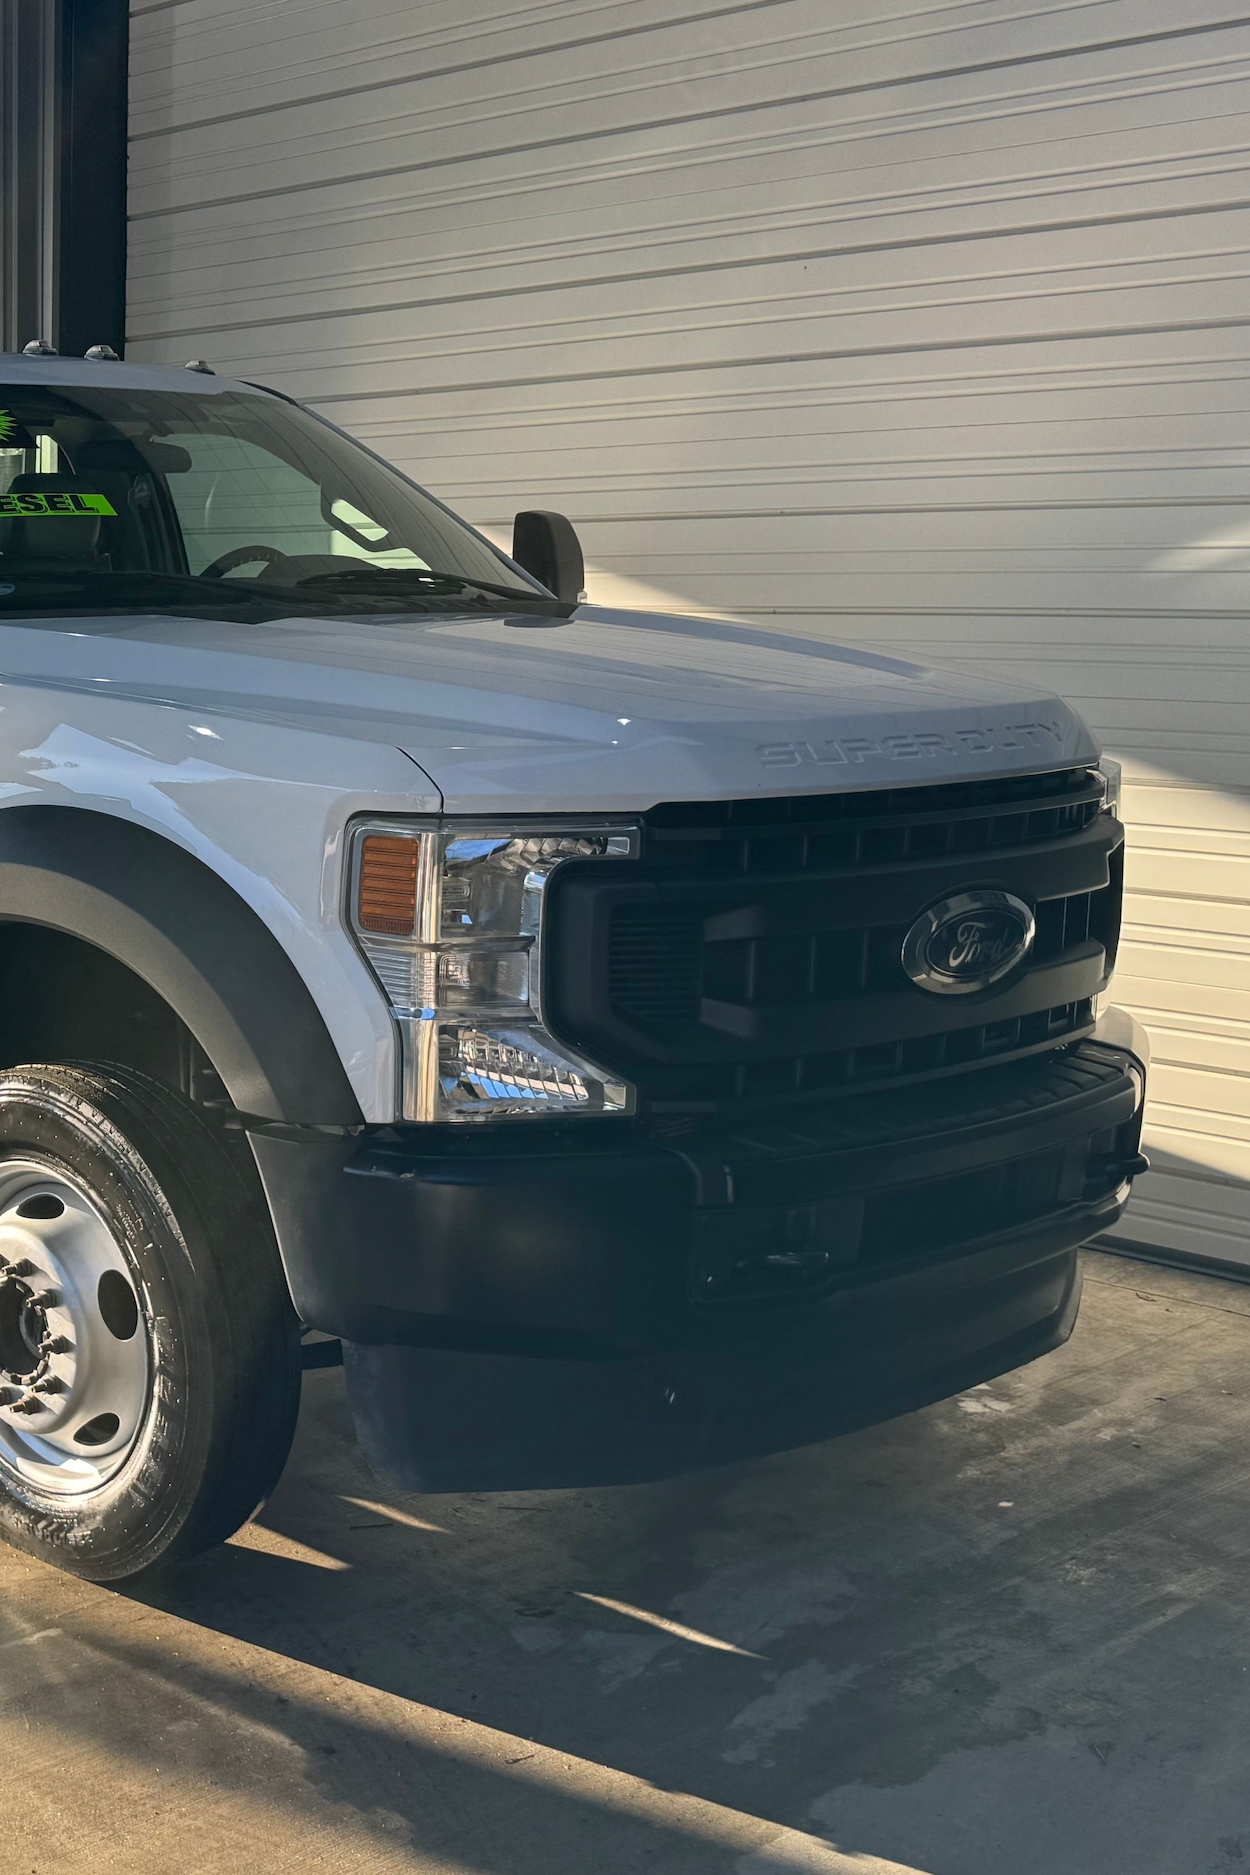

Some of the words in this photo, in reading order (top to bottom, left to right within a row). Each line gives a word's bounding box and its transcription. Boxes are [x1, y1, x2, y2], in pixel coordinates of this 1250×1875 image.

[757, 732, 955, 768] SUPER
[956, 721, 1063, 754] DUTY
[948, 920, 1014, 968] Ford
